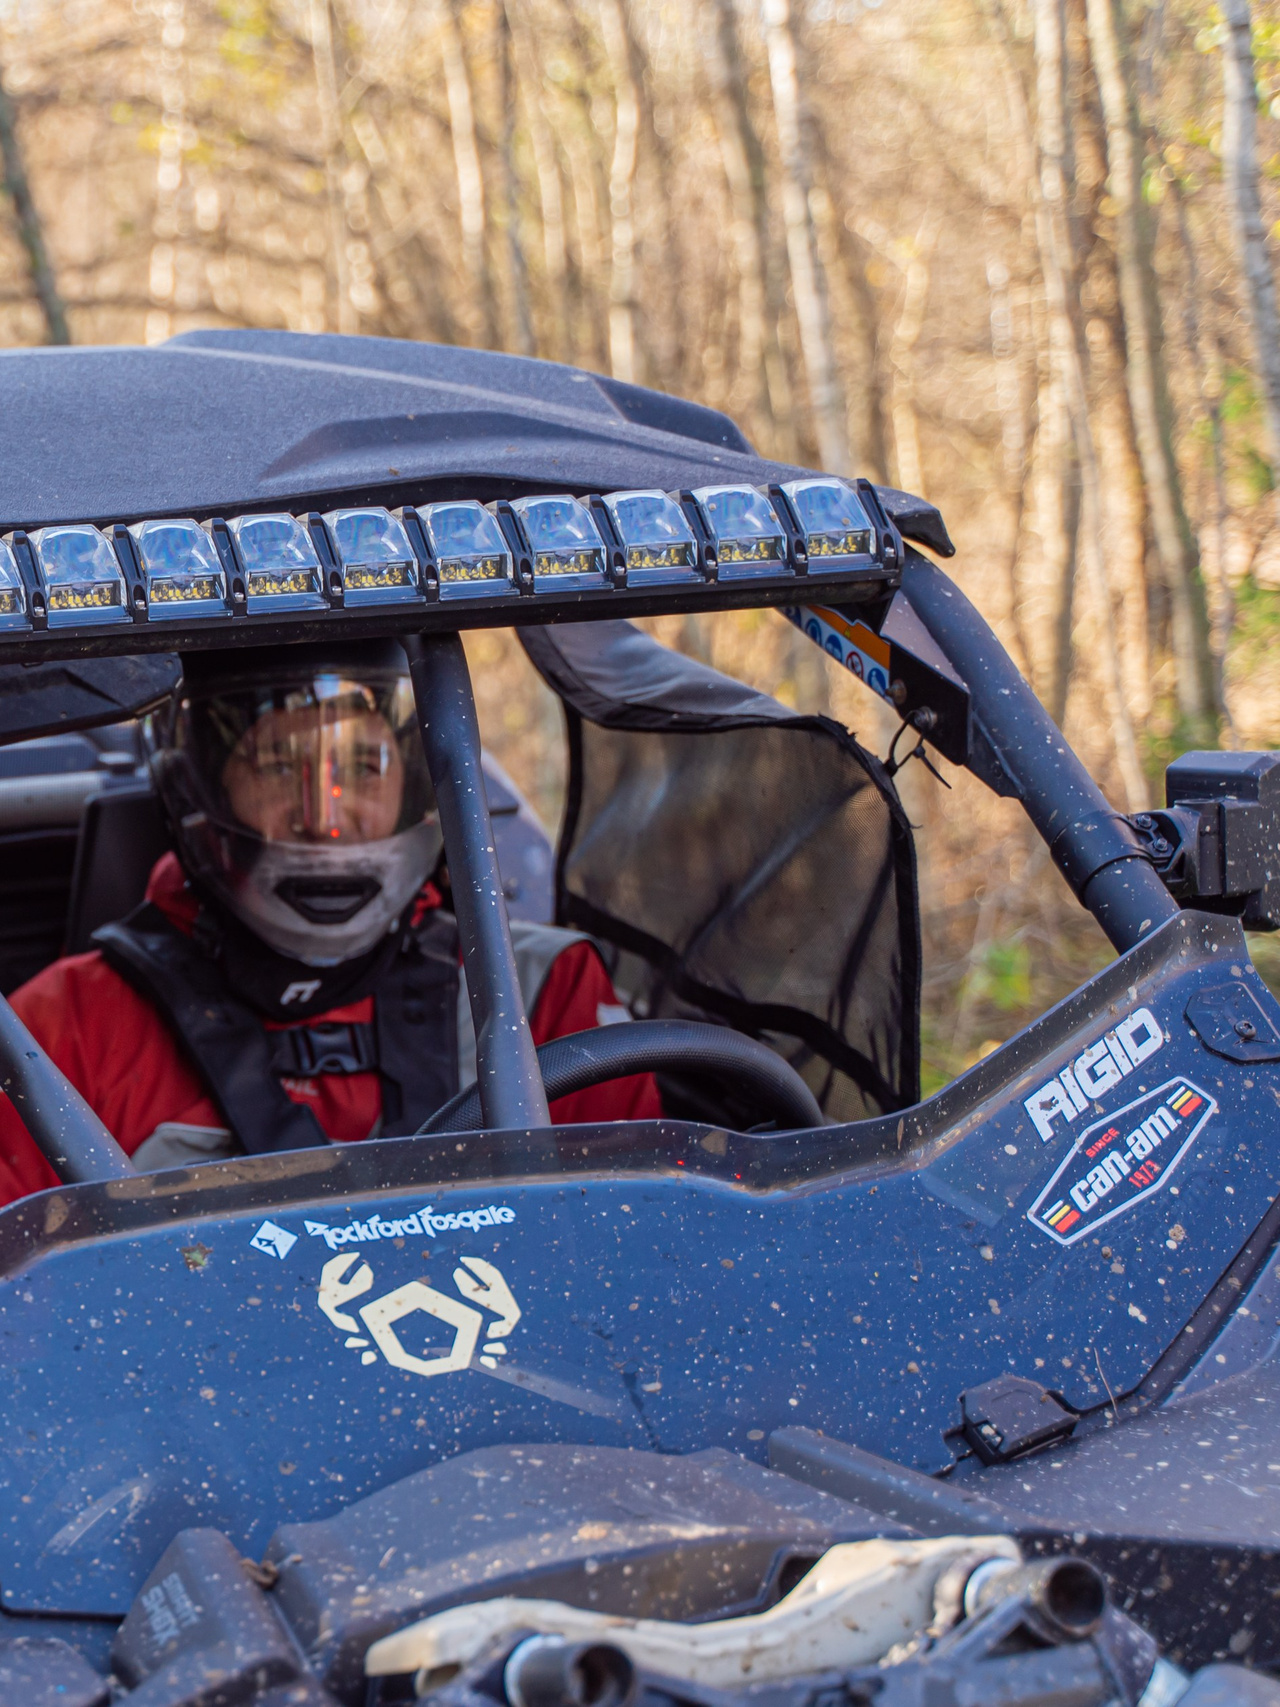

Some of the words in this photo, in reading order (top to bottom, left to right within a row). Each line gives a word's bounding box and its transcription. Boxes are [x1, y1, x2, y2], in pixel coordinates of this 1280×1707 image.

[1023, 1007, 1164, 1143] RIGID
[1070, 1105, 1178, 1213] can-am
[1085, 1127, 1120, 1158] SINCE
[1128, 1159, 1161, 1189] 1973
[303, 1214, 422, 1251] Rockford
